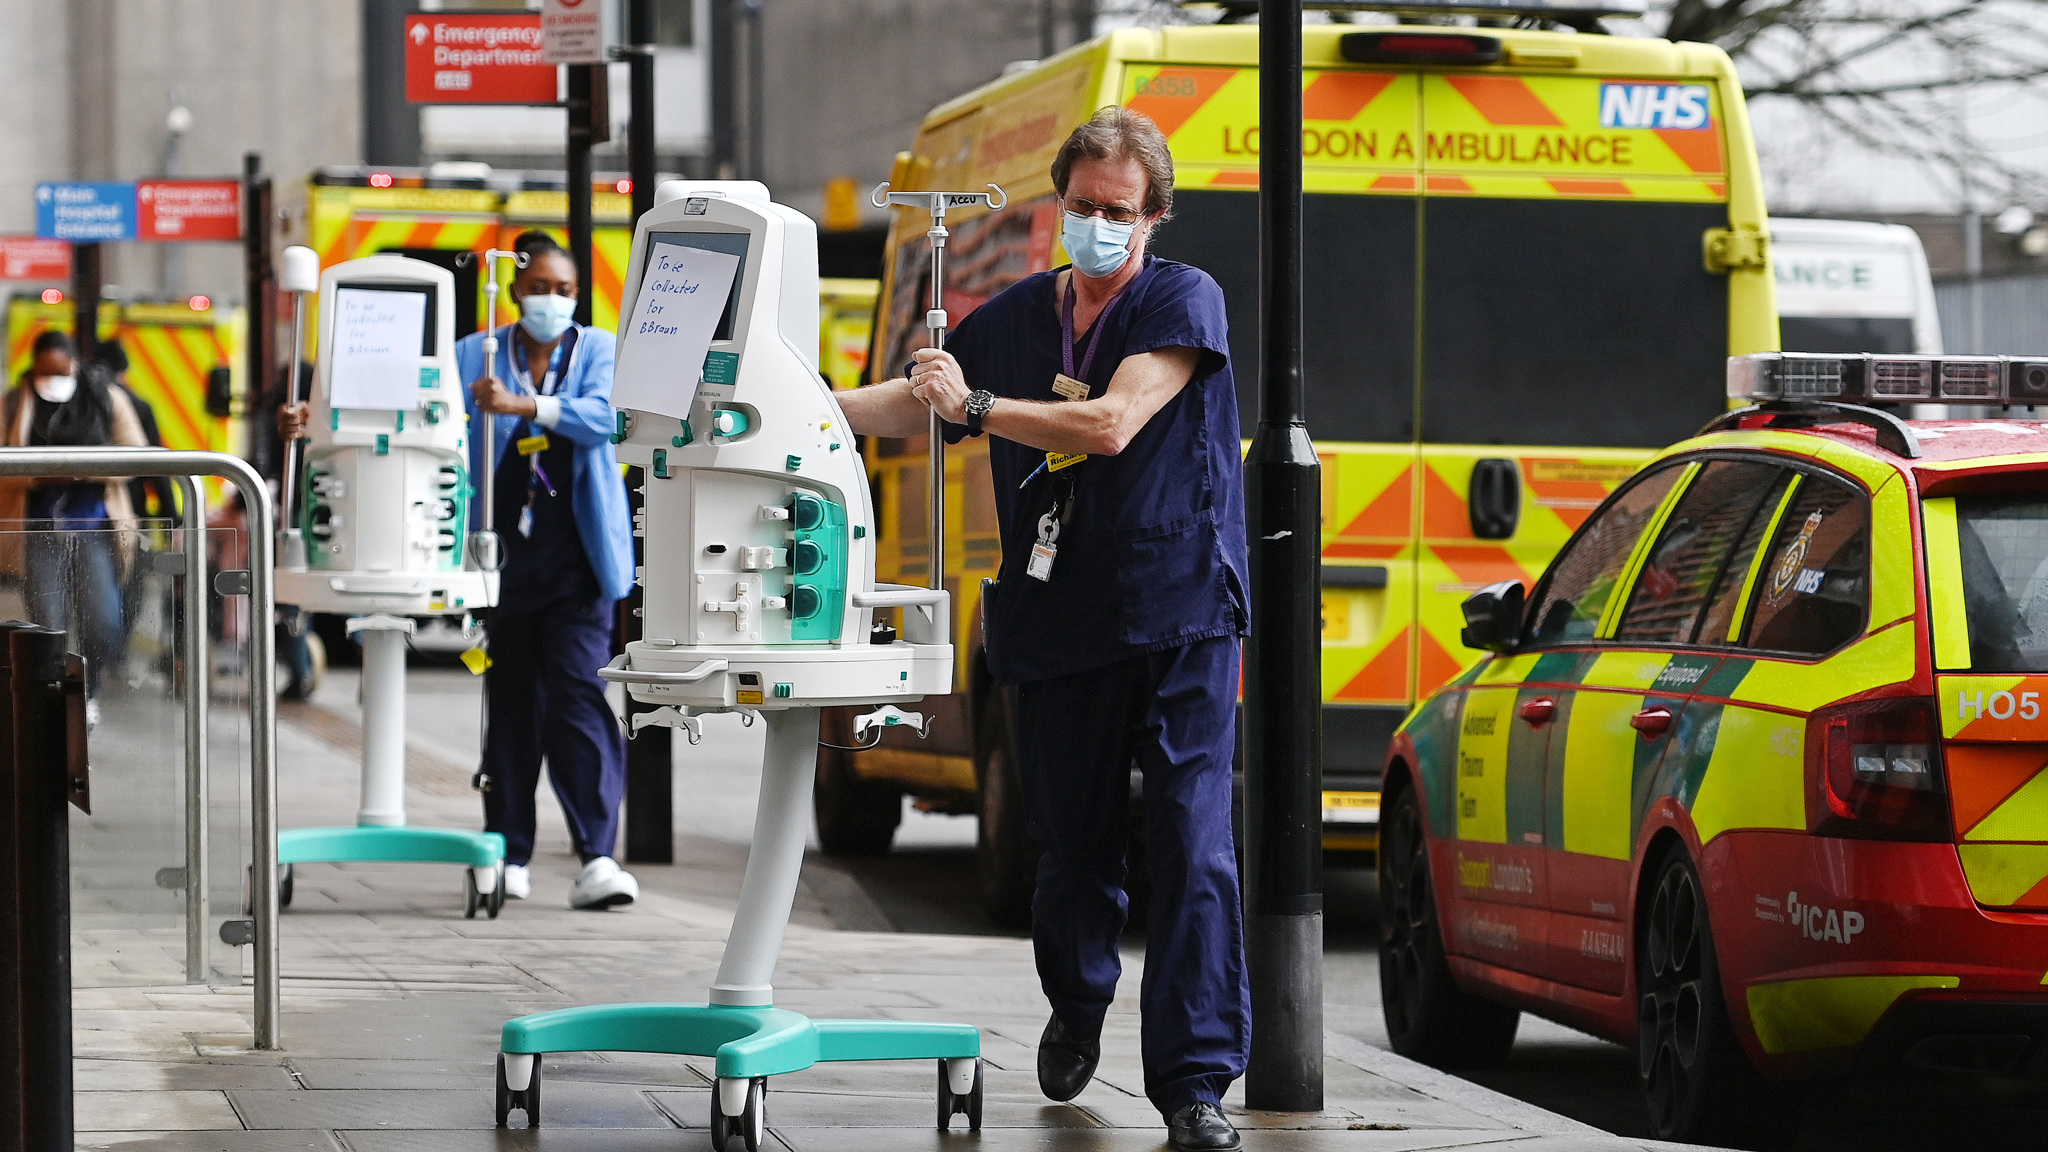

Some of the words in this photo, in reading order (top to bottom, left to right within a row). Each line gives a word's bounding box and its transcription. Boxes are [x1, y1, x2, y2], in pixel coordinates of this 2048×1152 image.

[434, 24, 542, 48] Emergency
[434, 46, 543, 69] Departmen
[1601, 83, 1708, 129] NHS
[1225, 126, 1376, 158] LODON
[1392, 132, 1633, 164] AMBULANCE
[949, 195, 977, 207] ACCU
[658, 255, 669, 270] To
[1794, 568, 1824, 594] NHS
[1657, 662, 1709, 688] Equipped
[1803, 904, 1865, 945] ICAP
